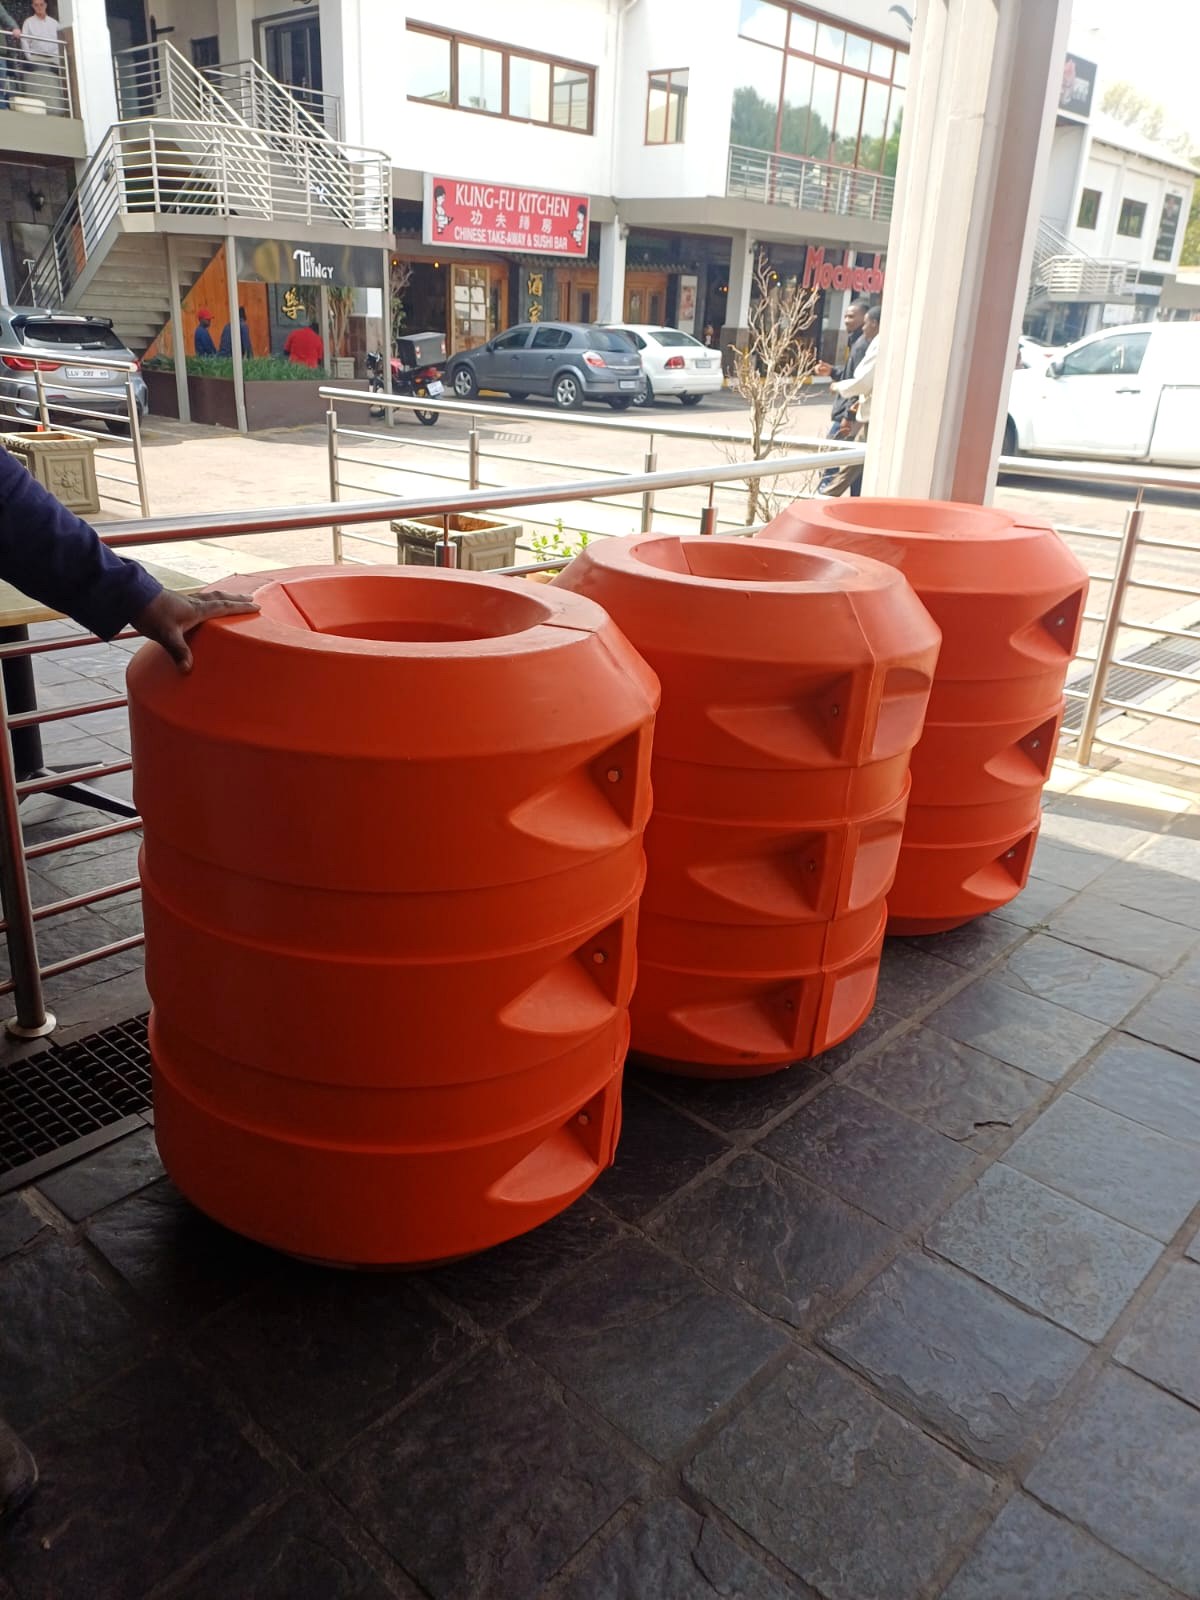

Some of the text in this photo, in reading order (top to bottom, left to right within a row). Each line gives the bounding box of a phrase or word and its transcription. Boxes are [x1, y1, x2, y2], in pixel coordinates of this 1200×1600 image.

[455, 184, 570, 218] KUNG-FU KITCHEN
[454, 226, 568, 250] CHINESE TAKE-AWAY & SUSHI BAR
[300, 258, 334, 279] THINGY
